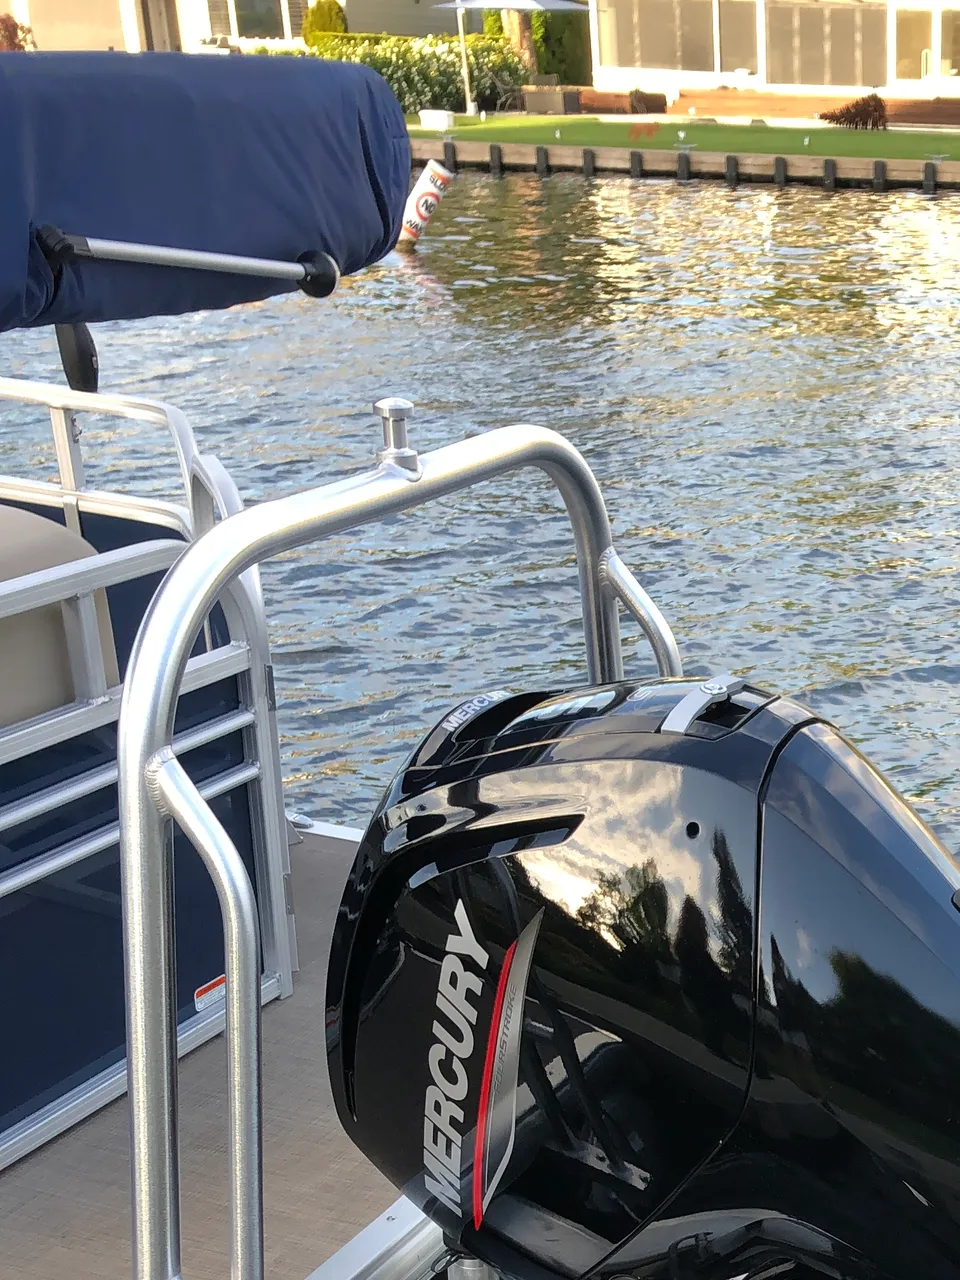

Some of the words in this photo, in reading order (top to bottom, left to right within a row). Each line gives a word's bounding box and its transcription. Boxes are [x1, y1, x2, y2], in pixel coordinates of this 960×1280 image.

[406, 219, 424, 237] WAK
[421, 199, 437, 214] NO
[423, 898, 490, 1218] MERCURY
[494, 983, 517, 1094] FOURSTROKE
